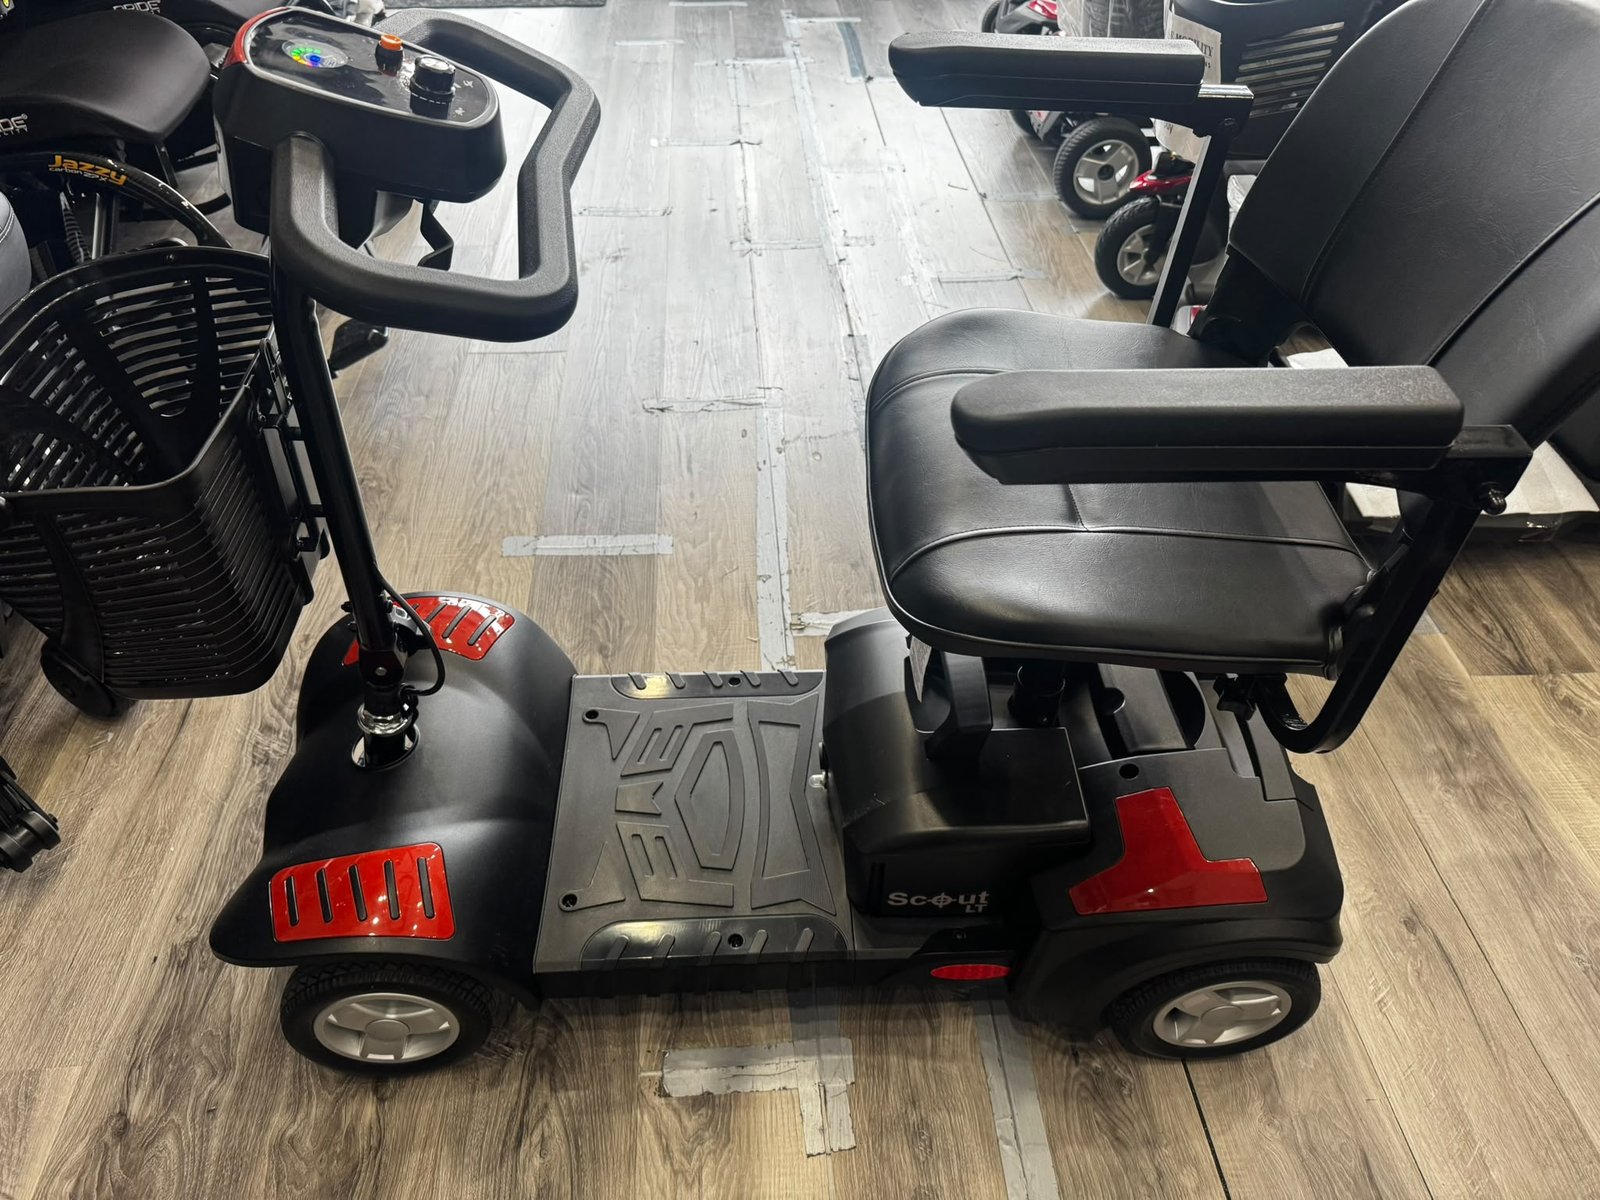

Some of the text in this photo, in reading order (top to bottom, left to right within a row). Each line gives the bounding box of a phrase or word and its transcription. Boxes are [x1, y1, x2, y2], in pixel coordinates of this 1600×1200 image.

[48, 155, 127, 186] Jazzy
[887, 890, 989, 908] Scout
[965, 904, 988, 913] LT
